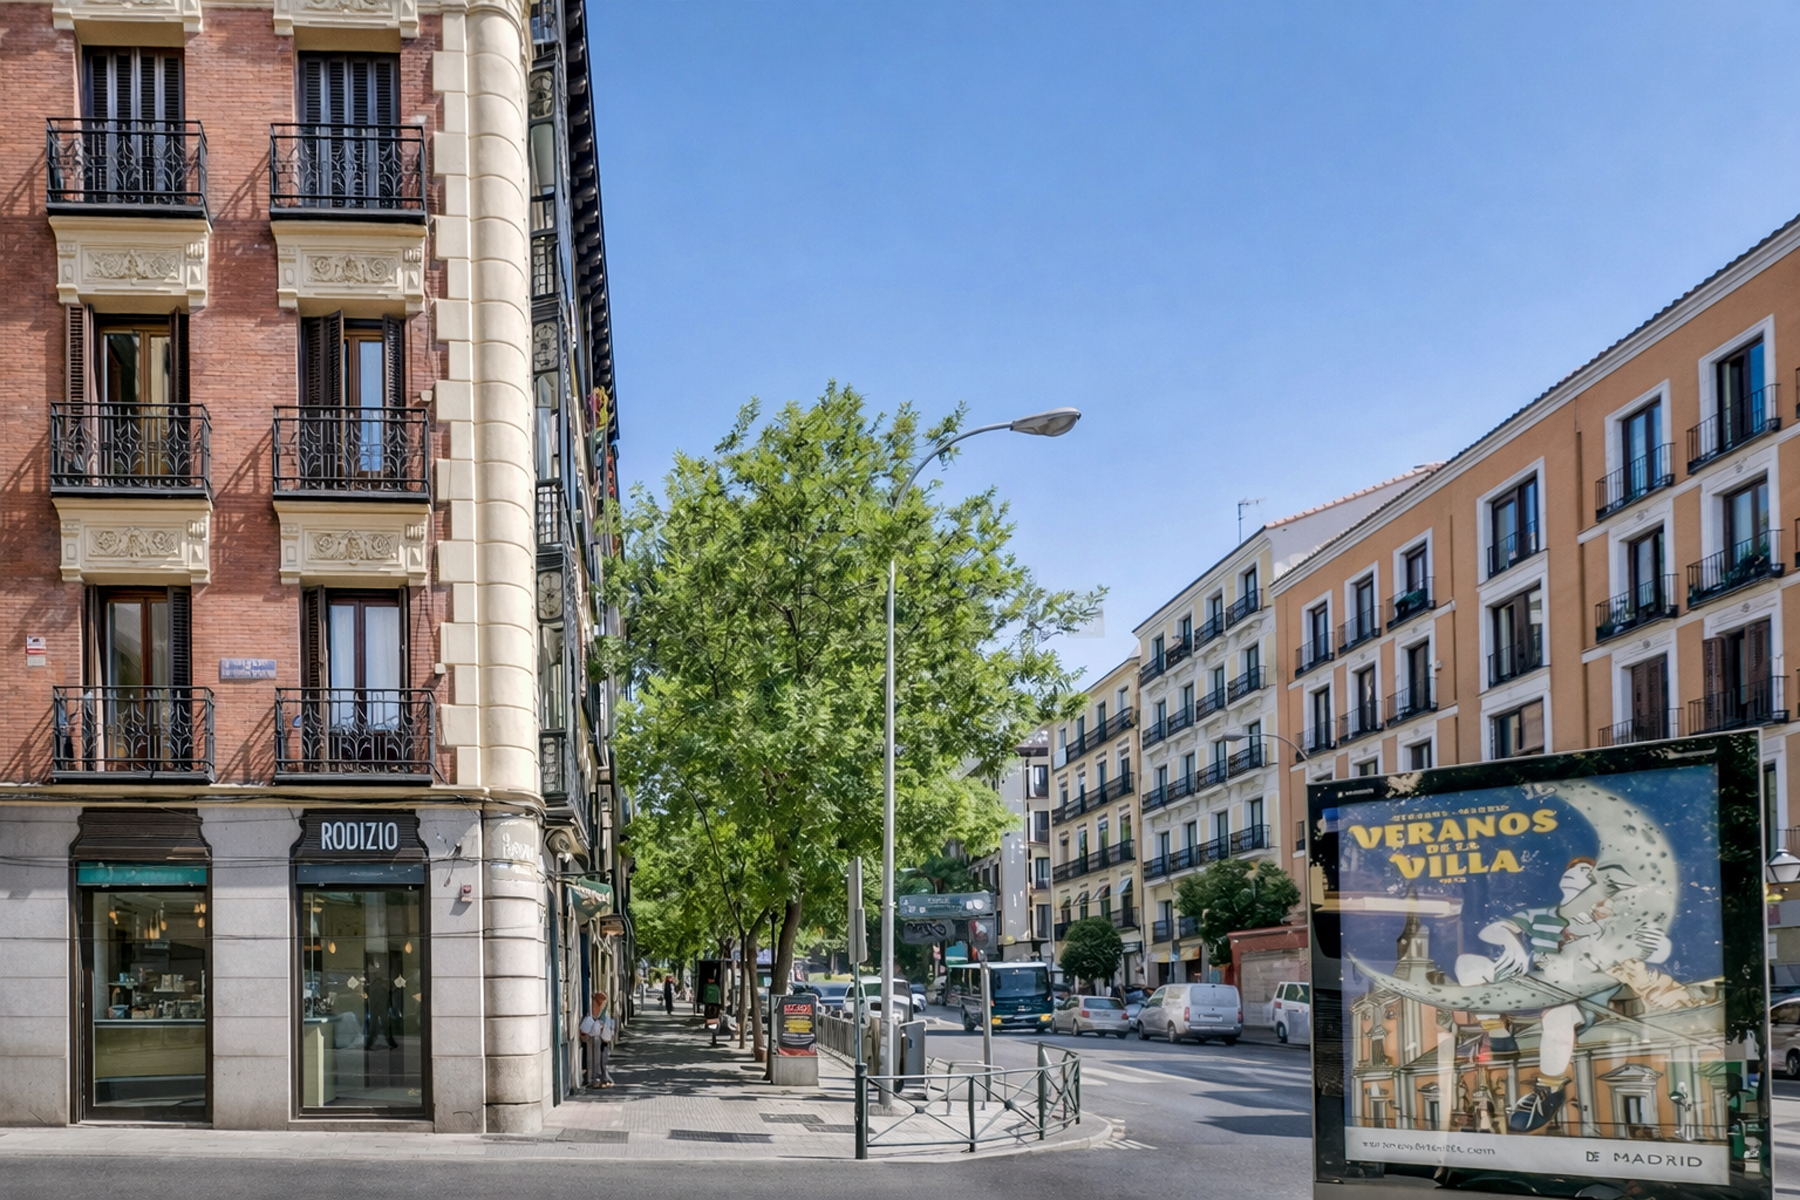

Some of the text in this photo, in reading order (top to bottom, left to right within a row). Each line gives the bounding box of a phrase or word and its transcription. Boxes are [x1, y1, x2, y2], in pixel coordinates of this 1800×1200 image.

[320, 821, 399, 851] RODIZIO
[1348, 808, 1559, 850] VERANOS
[1389, 849, 1526, 879] VILLA
[1585, 1150, 1703, 1168] DE MADRID
